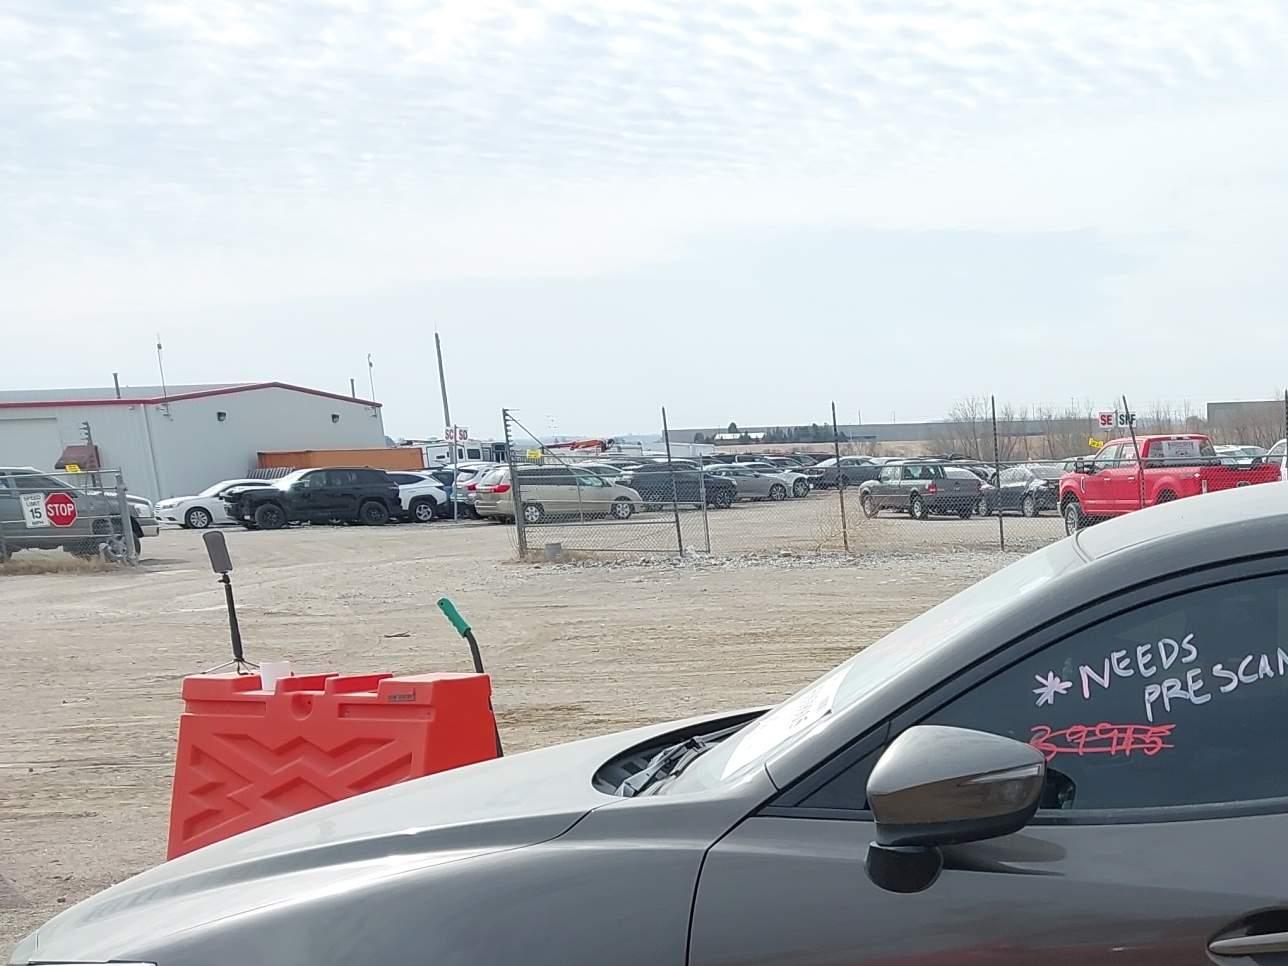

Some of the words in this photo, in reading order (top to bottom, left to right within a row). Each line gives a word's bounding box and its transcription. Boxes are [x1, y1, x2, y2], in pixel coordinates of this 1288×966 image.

[1101, 415, 1113, 425] SE
[30, 508, 42, 519] 15
[47, 503, 74, 517] STOP
[1079, 633, 1199, 699] NEEDS
